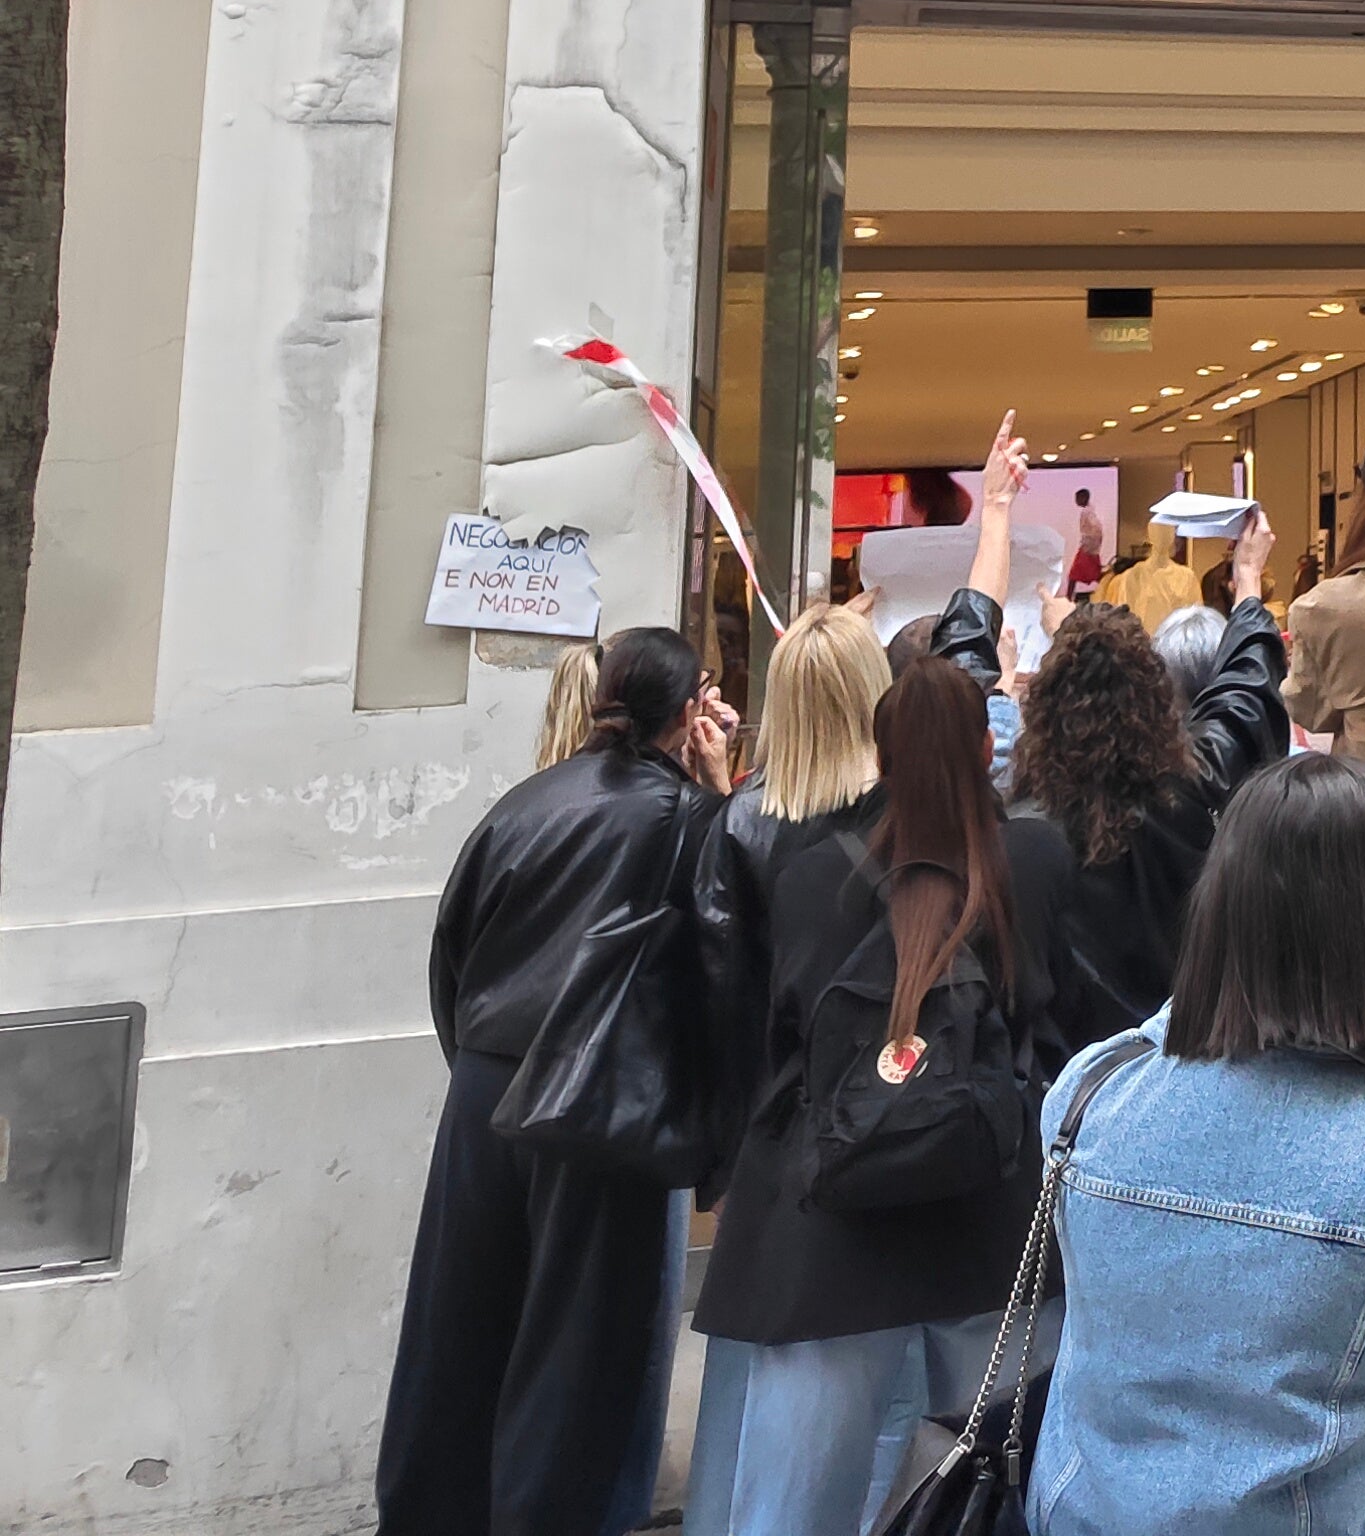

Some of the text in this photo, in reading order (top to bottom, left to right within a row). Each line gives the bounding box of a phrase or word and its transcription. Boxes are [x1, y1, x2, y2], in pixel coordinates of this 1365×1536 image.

[496, 553, 554, 573] AQUÍ
[444, 568, 559, 592] E NON EN
